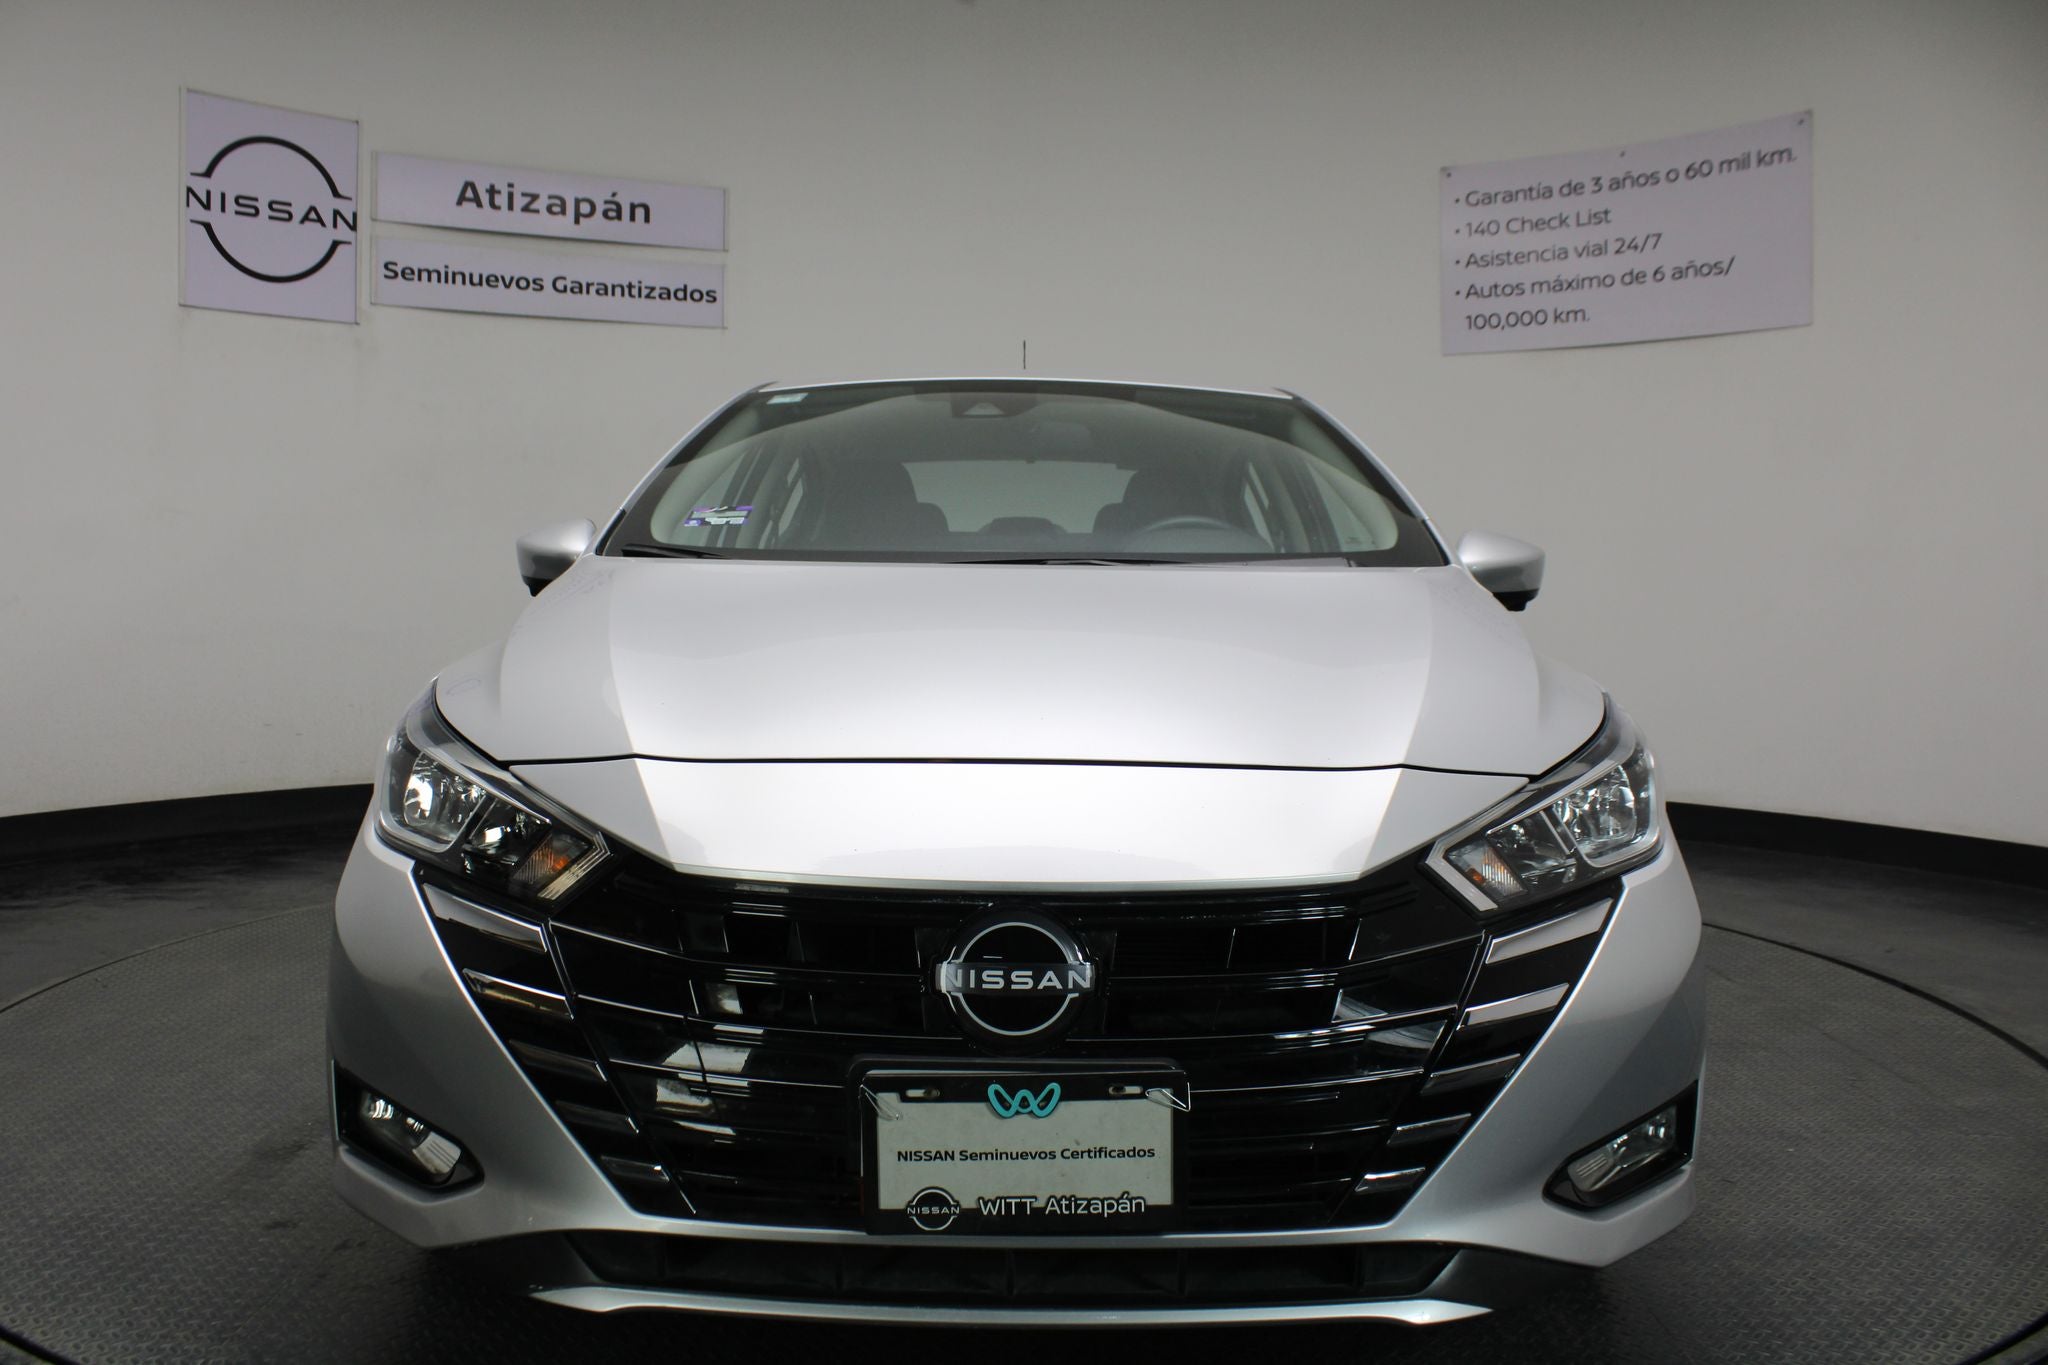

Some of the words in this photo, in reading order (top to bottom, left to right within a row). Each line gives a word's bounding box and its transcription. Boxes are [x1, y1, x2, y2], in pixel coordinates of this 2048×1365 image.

[1466, 182, 1554, 208] Garantía
[1559, 178, 1585, 199] de
[1591, 177, 1603, 194] 3
[1609, 168, 1661, 192] años
[1665, 168, 1680, 184] o
[1686, 161, 1714, 181] 60
[1719, 151, 1751, 174] mil
[1756, 146, 1797, 169] km.
[186, 186, 357, 232] NISSAN
[456, 180, 652, 225] Atizapán
[1466, 220, 1500, 238] 140
[1506, 213, 1570, 236] Check
[1576, 209, 1611, 229] List
[1466, 244, 1569, 270] Asistencia
[1574, 240, 1609, 260] vial
[1614, 233, 1664, 256] 24/7
[383, 260, 544, 293] Seminuevos
[551, 275, 718, 304] Garantizados
[1466, 281, 1526, 300] Autos
[1531, 273, 1615, 297] máximo
[1621, 268, 1648, 288] de
[1653, 266, 1666, 283] 6
[1671, 256, 1736, 281] años/
[1466, 311, 1548, 332] 100,000
[1553, 306, 1590, 325] km.
[946, 969, 1092, 990] NISSAN
[897, 1150, 955, 1162] NISSAN
[959, 1149, 1057, 1162] Seminuevos
[1060, 1146, 1155, 1161] Certificados
[907, 1206, 960, 1215] NISSAN
[979, 1198, 1037, 1216] WITT
[1045, 1191, 1146, 1218] Atizapán
